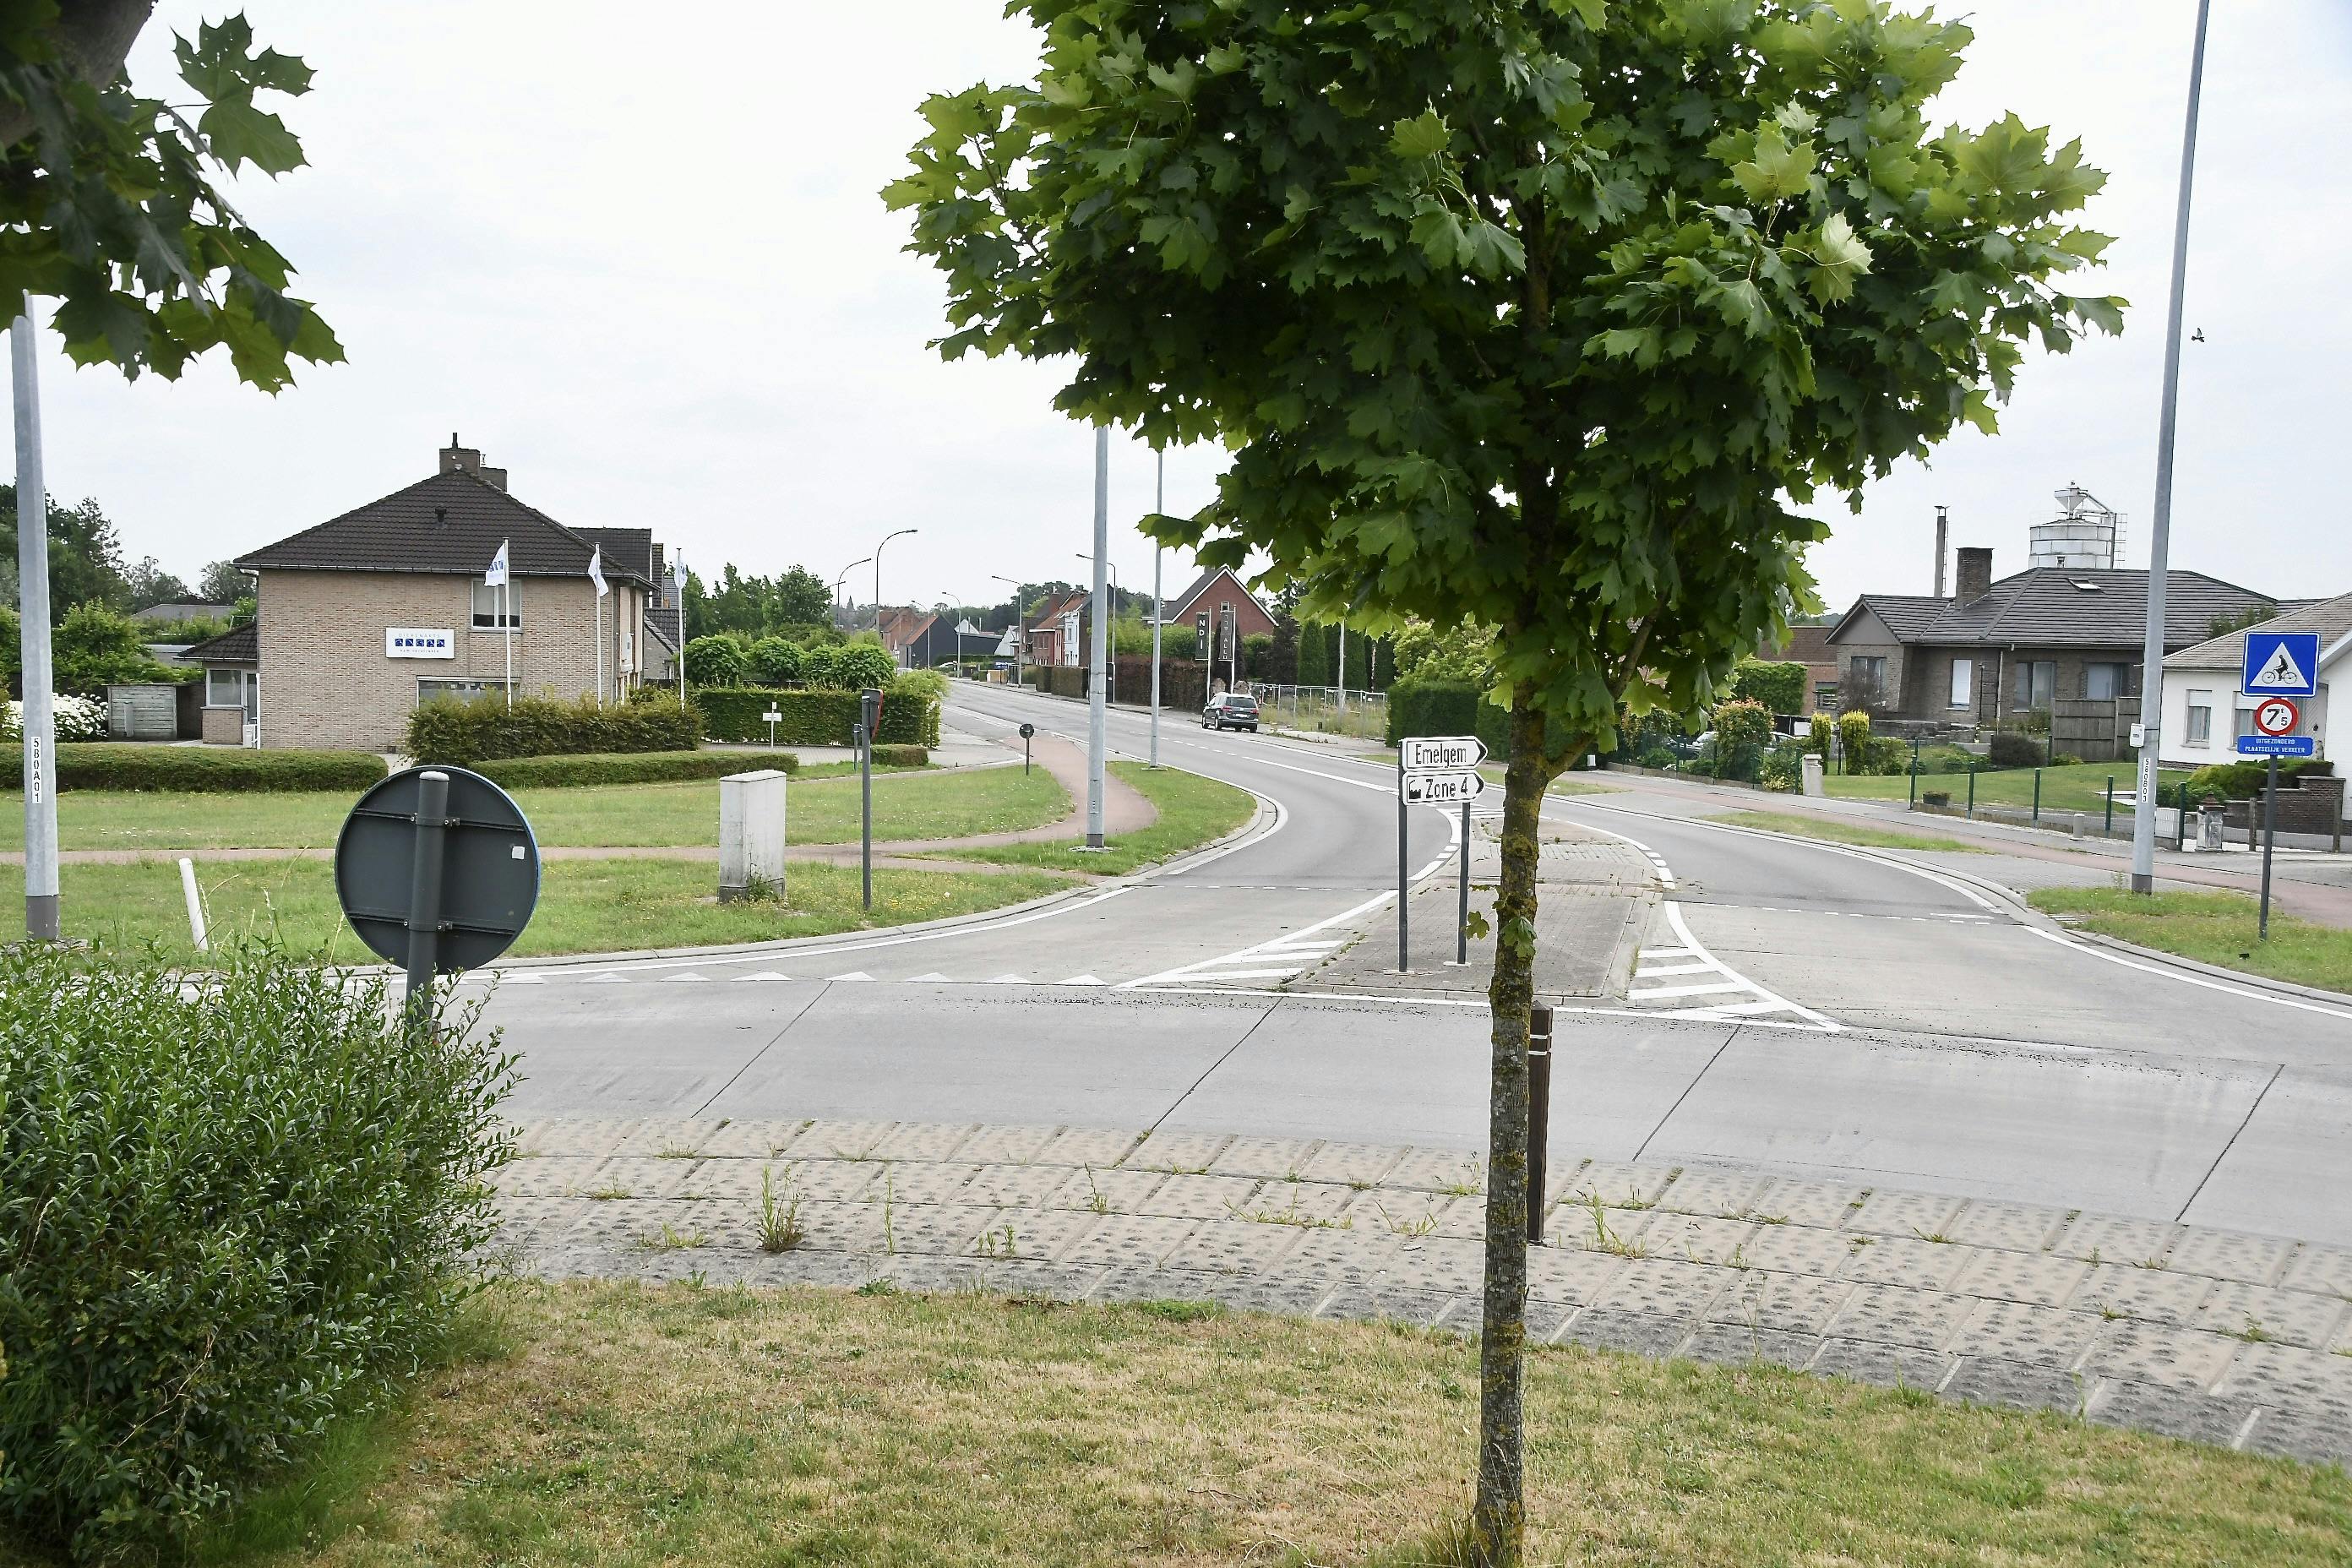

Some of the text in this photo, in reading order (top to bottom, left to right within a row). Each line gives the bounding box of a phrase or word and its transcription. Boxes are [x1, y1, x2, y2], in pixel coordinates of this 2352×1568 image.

[1415, 743, 1467, 769] Emelgem
[1425, 776, 1468, 799] Zone 4
